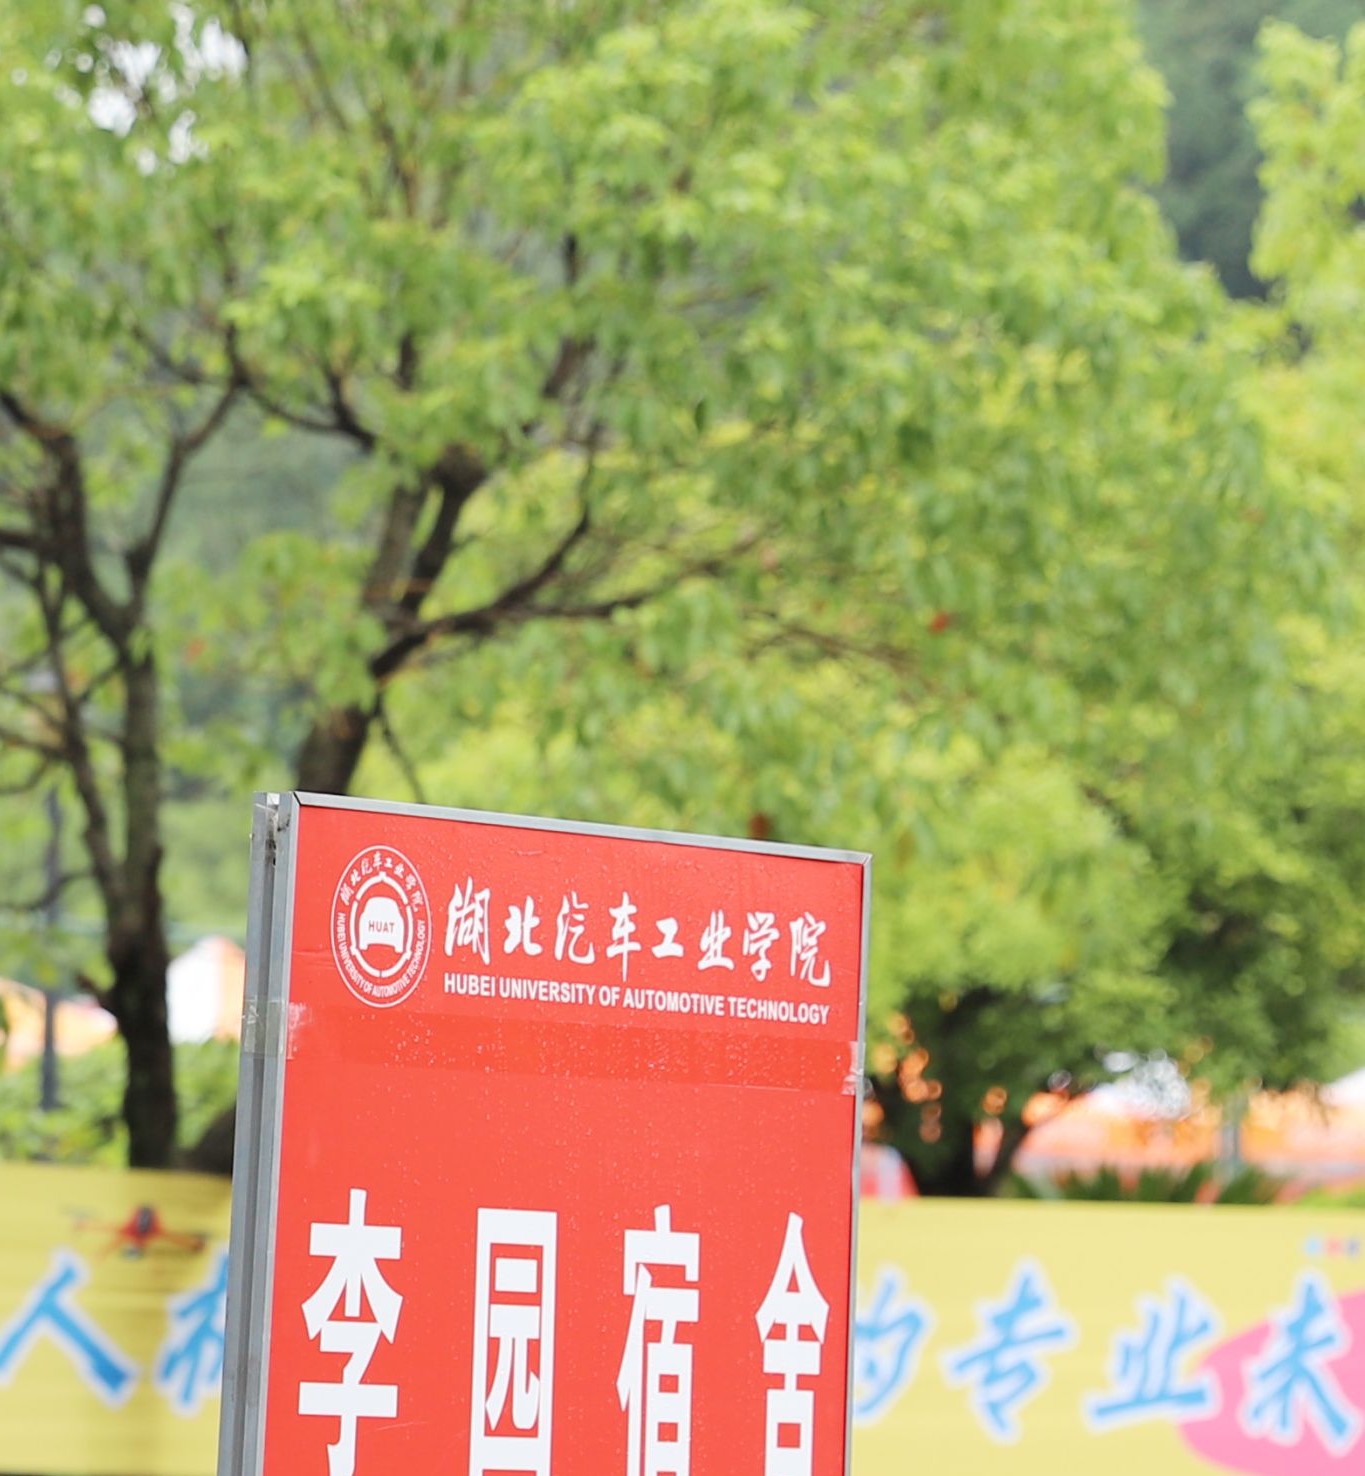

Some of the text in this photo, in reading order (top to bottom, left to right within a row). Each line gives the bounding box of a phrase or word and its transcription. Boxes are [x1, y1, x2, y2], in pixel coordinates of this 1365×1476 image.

[368, 919, 396, 934] HUAT
[444, 876, 831, 987] 湖北汽车工业学院
[444, 973, 830, 1025] HUBEI UNIVERSITY OF AUTOMOTIVE TECHNOLOGY
